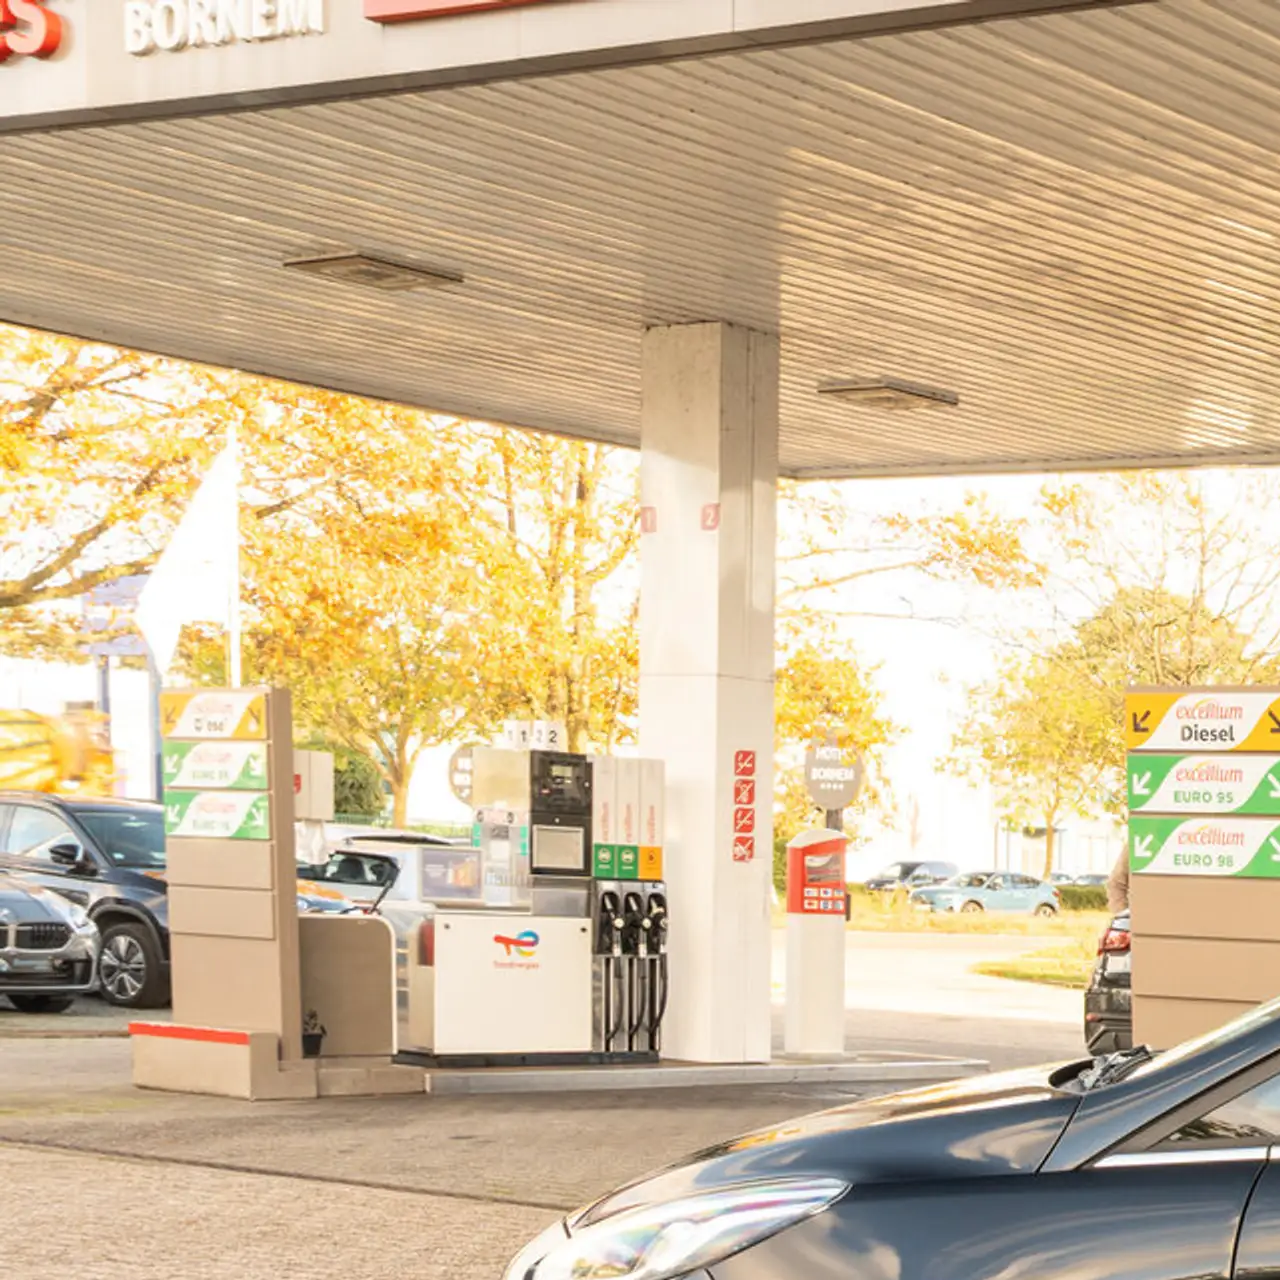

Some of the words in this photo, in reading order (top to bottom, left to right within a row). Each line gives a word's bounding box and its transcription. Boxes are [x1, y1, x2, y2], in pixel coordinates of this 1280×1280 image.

[124, 0, 326, 56] BORNEM
[1175, 699, 1244, 720] excellium
[1180, 724, 1236, 742] Diesel
[1175, 763, 1244, 783] excellium
[1173, 790, 1213, 804] EURO
[1216, 791, 1235, 804] 95
[1177, 825, 1246, 846] excellium
[1173, 853, 1213, 868] EURO
